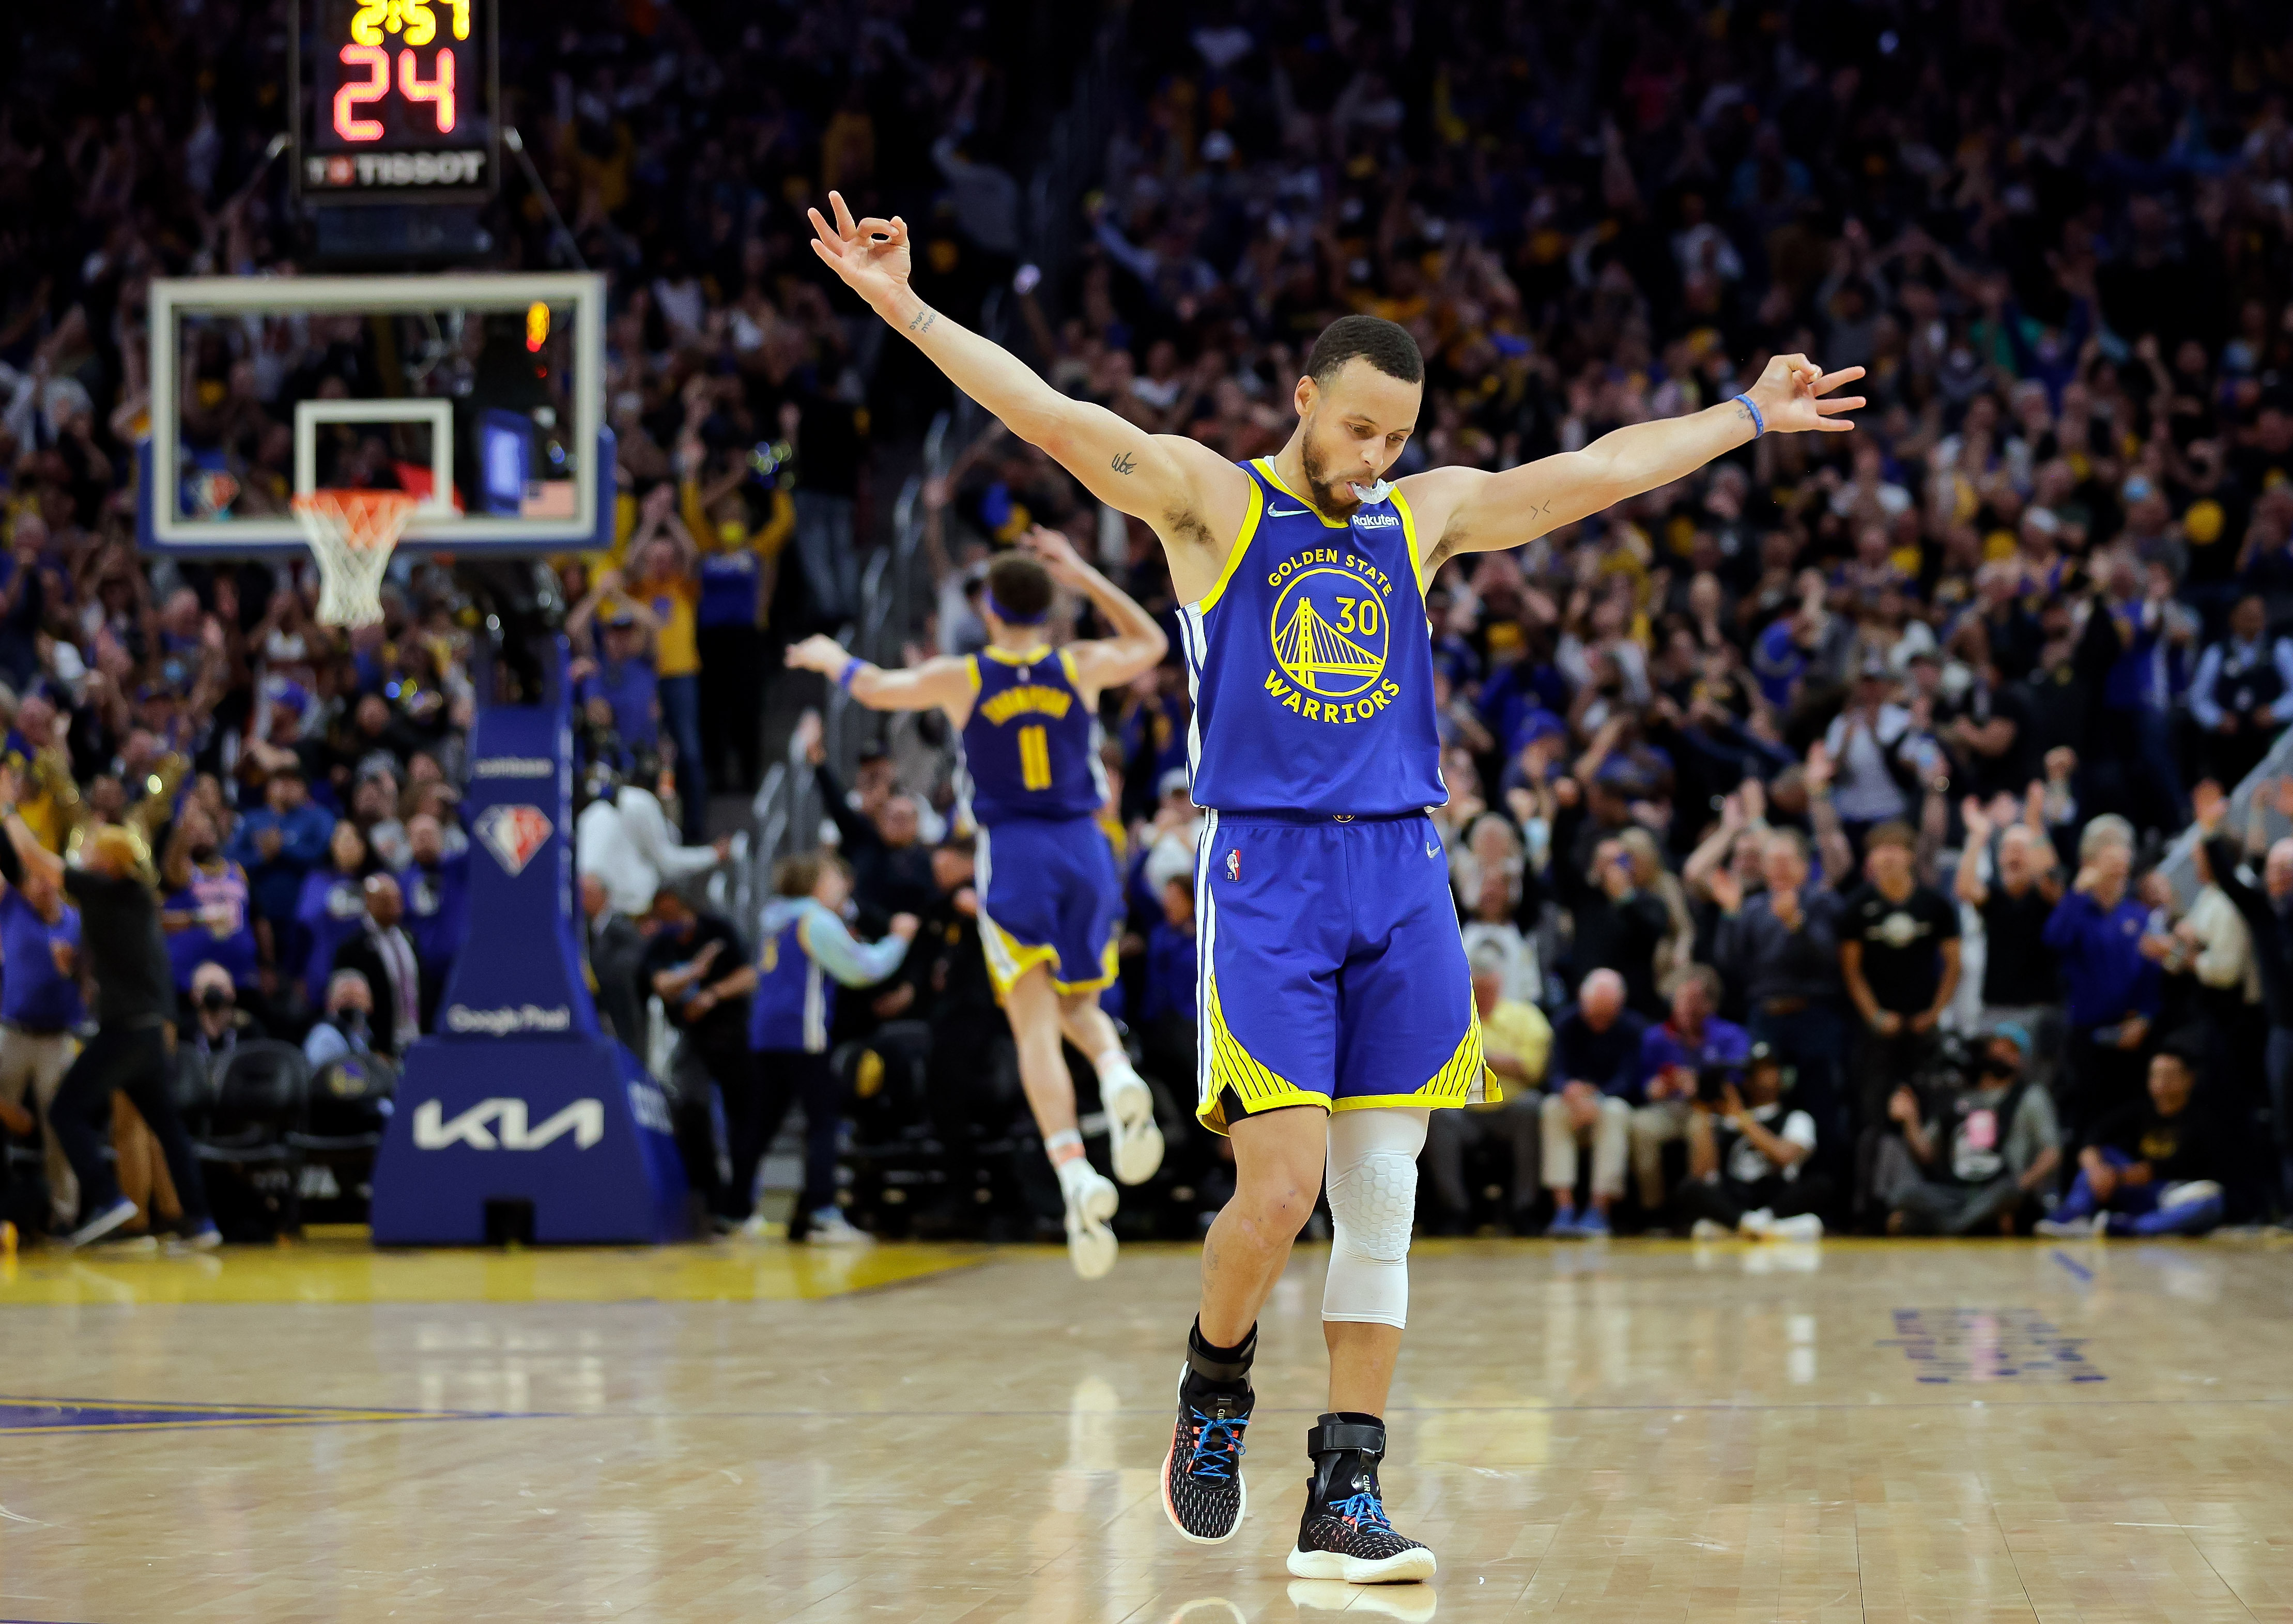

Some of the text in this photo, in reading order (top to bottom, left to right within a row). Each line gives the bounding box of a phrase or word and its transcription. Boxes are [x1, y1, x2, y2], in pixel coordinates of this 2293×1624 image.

[334, 44, 455, 141] 24
[358, 150, 486, 185] TISSOT
[1352, 514, 1399, 526] Rakuten
[1268, 548, 1393, 597] GOLDEN STATE
[1335, 596, 1378, 636] 30
[1264, 669, 1399, 724] WARRIORS
[1018, 725, 1052, 792] 11
[413, 1097, 604, 1150] KIA
